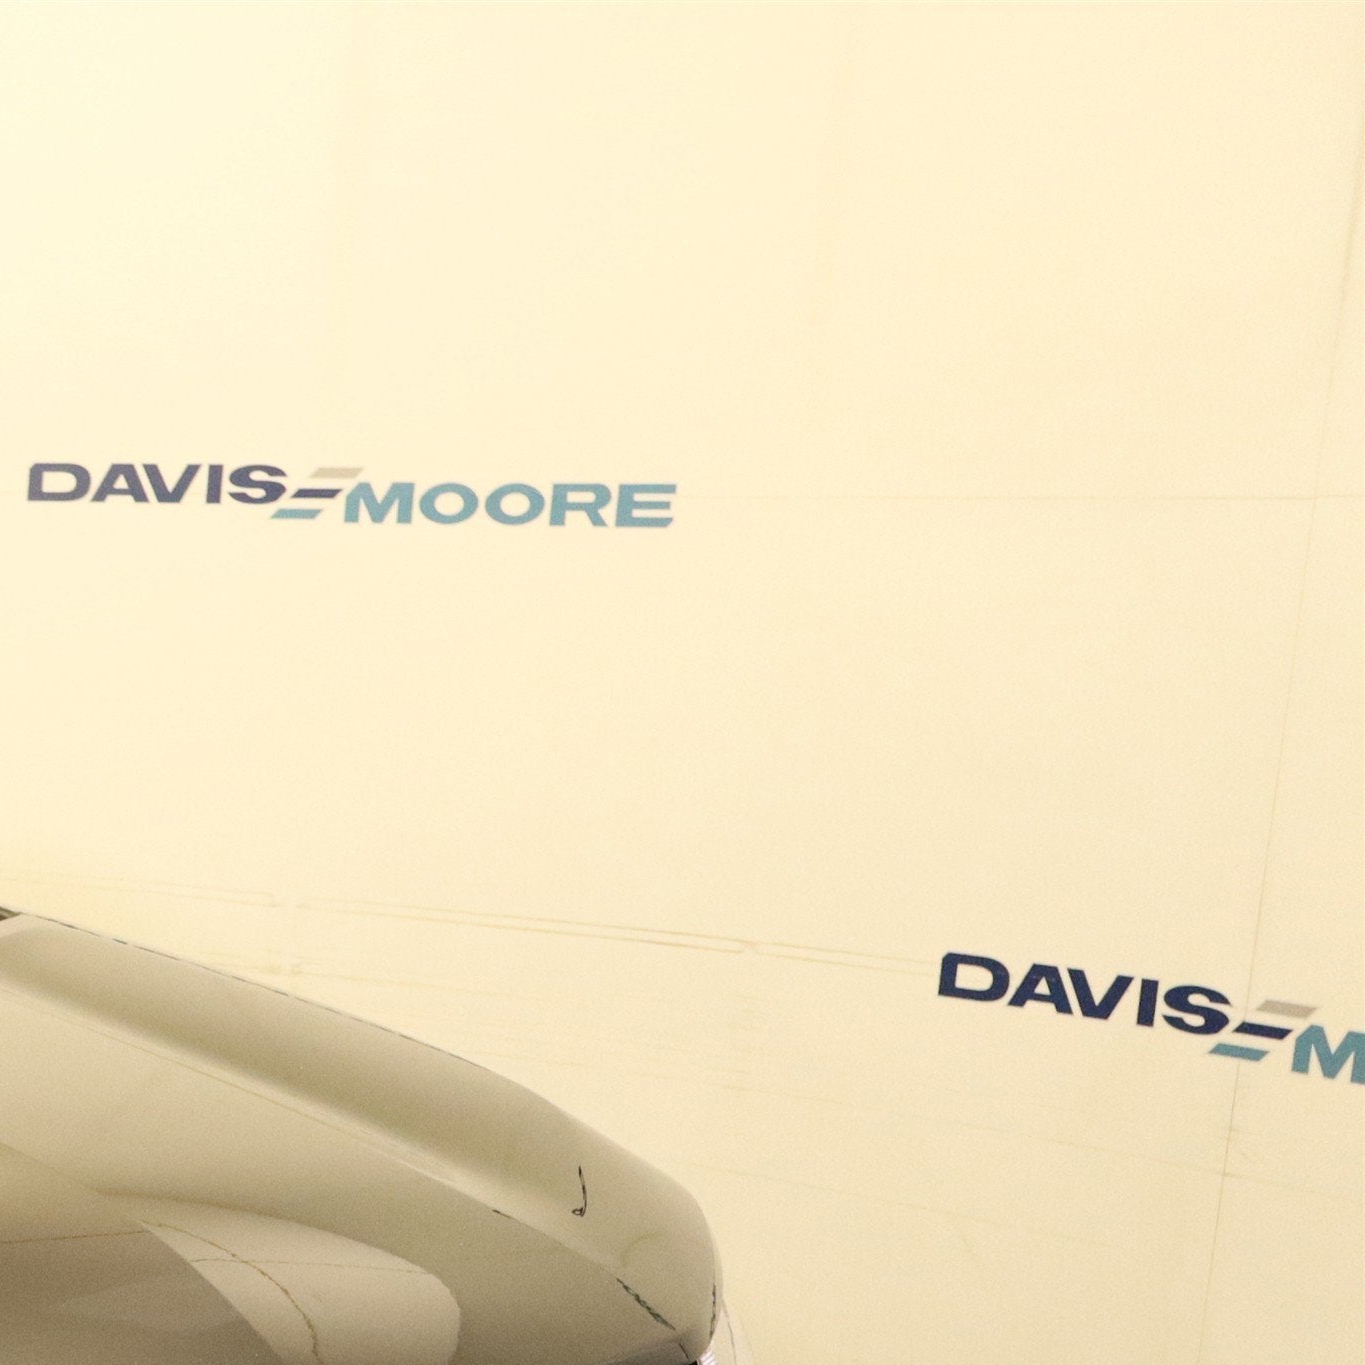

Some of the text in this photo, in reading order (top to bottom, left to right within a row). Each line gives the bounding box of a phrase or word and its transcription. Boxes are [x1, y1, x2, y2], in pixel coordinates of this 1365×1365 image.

[27, 462, 677, 528] DAVIS MOORE
[938, 951, 1232, 1035] DAVIS
